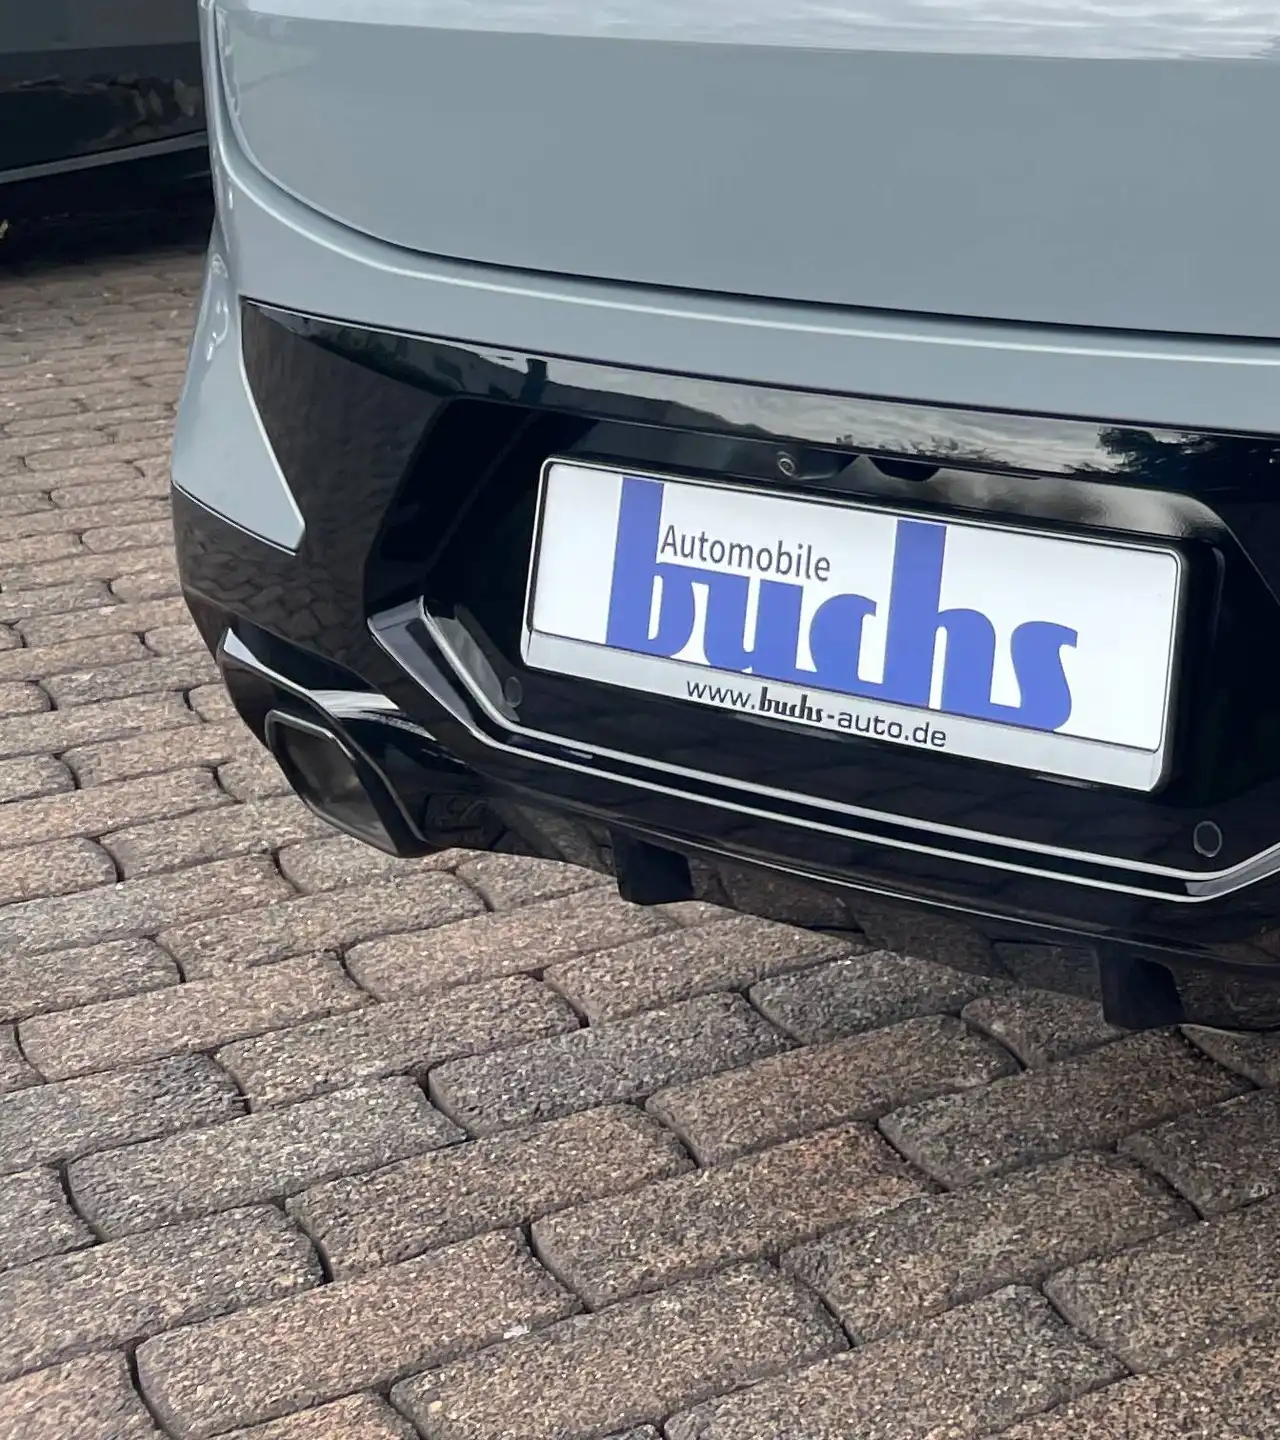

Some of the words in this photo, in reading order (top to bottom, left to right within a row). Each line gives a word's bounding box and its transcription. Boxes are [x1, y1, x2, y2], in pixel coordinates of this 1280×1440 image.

[658, 523, 832, 582] Automobile
[605, 476, 1079, 733] buchs
[686, 678, 947, 749] www.buchs-auto.de
